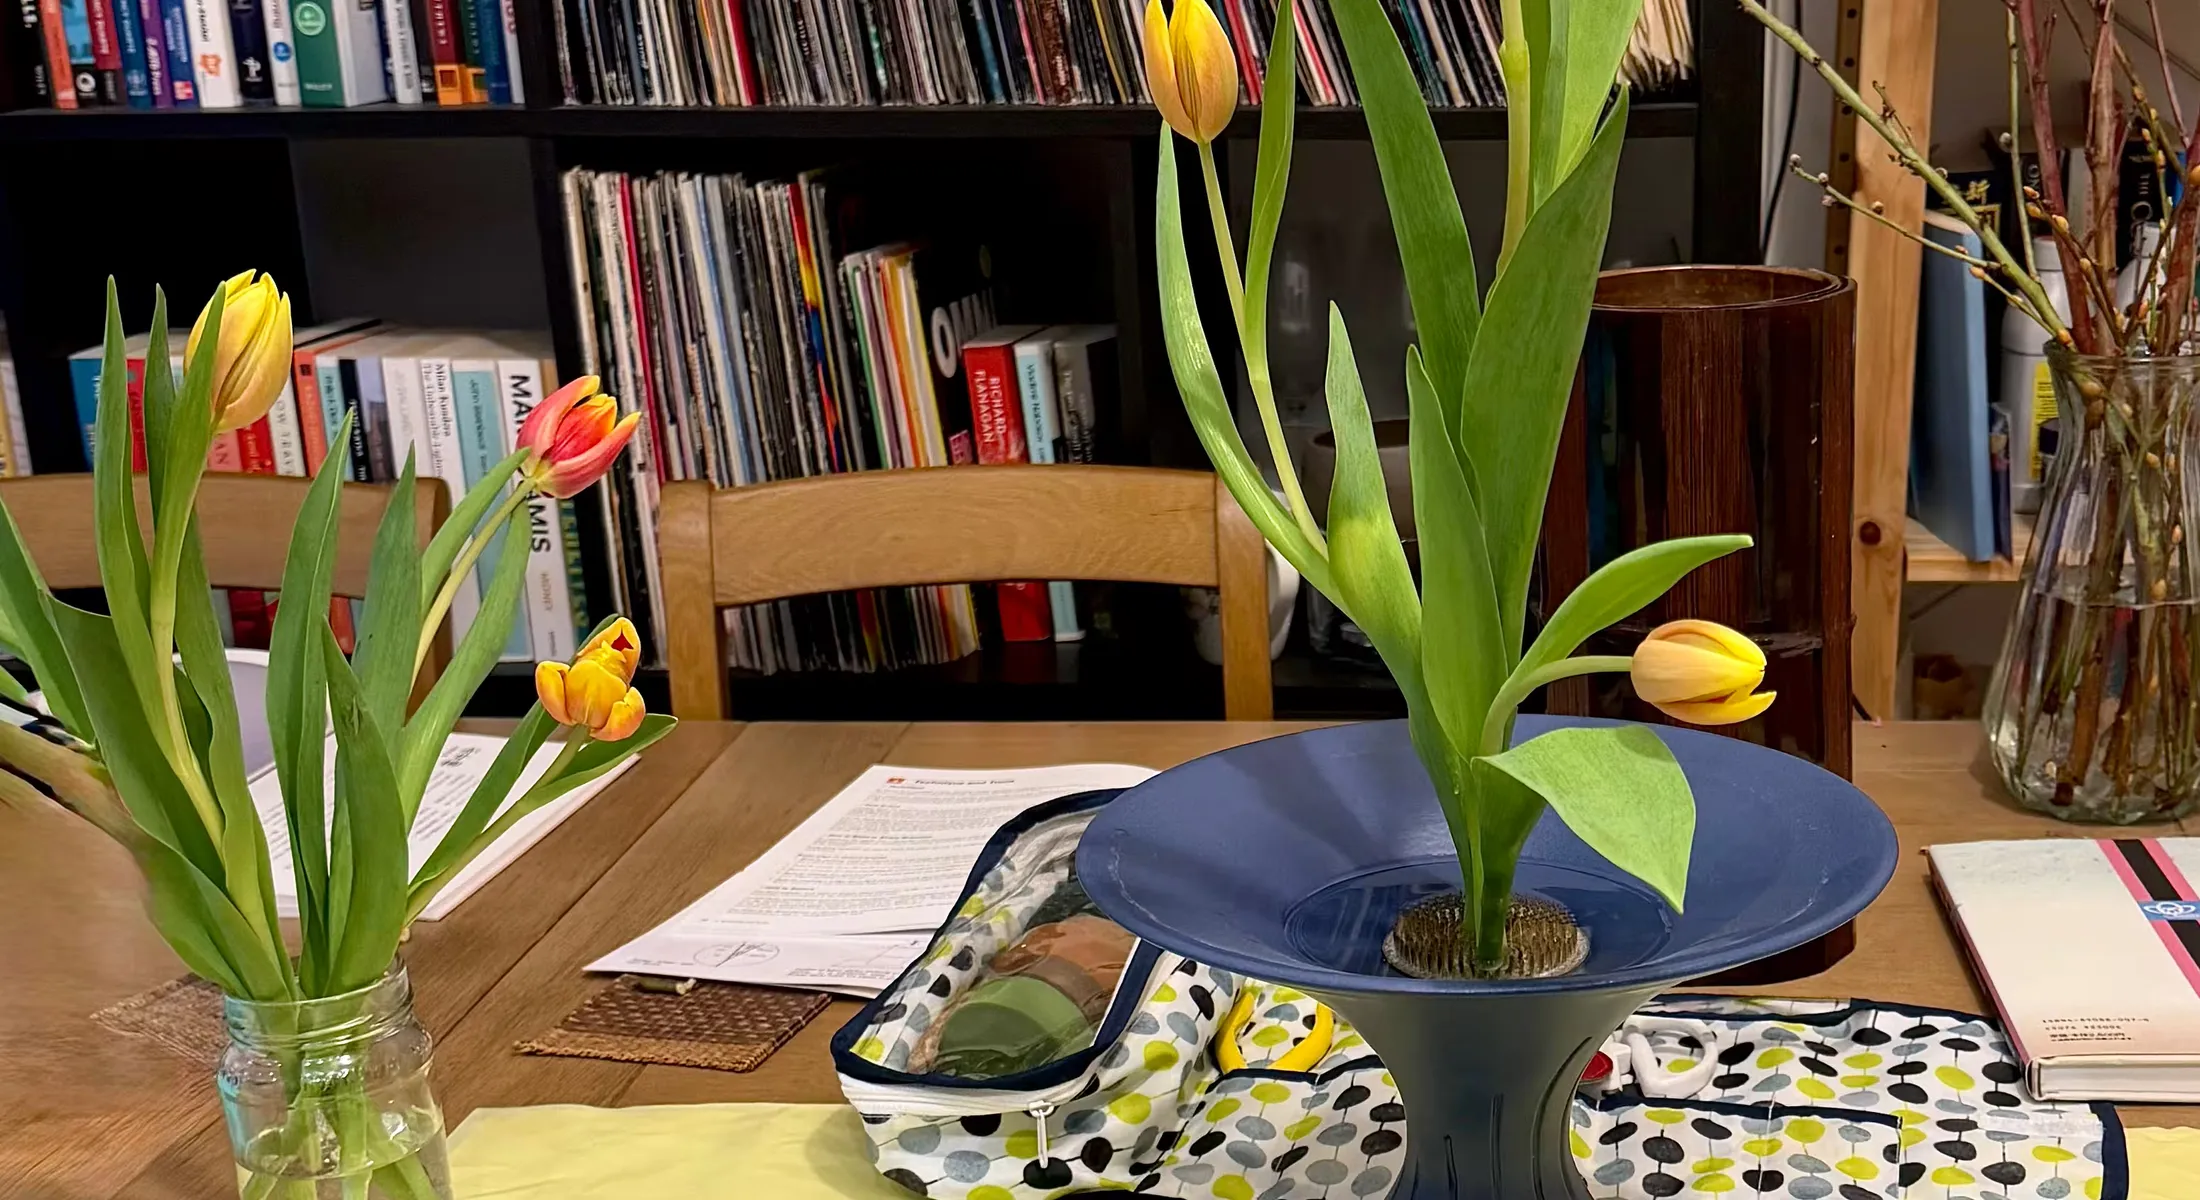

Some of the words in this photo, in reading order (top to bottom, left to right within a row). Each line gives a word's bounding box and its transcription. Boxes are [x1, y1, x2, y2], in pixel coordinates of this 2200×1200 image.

[435, 364, 447, 393] Milan
[438, 396, 452, 437] Kundera
[974, 370, 995, 443] FLANAGAN
[989, 376, 1007, 434] RICHARD
